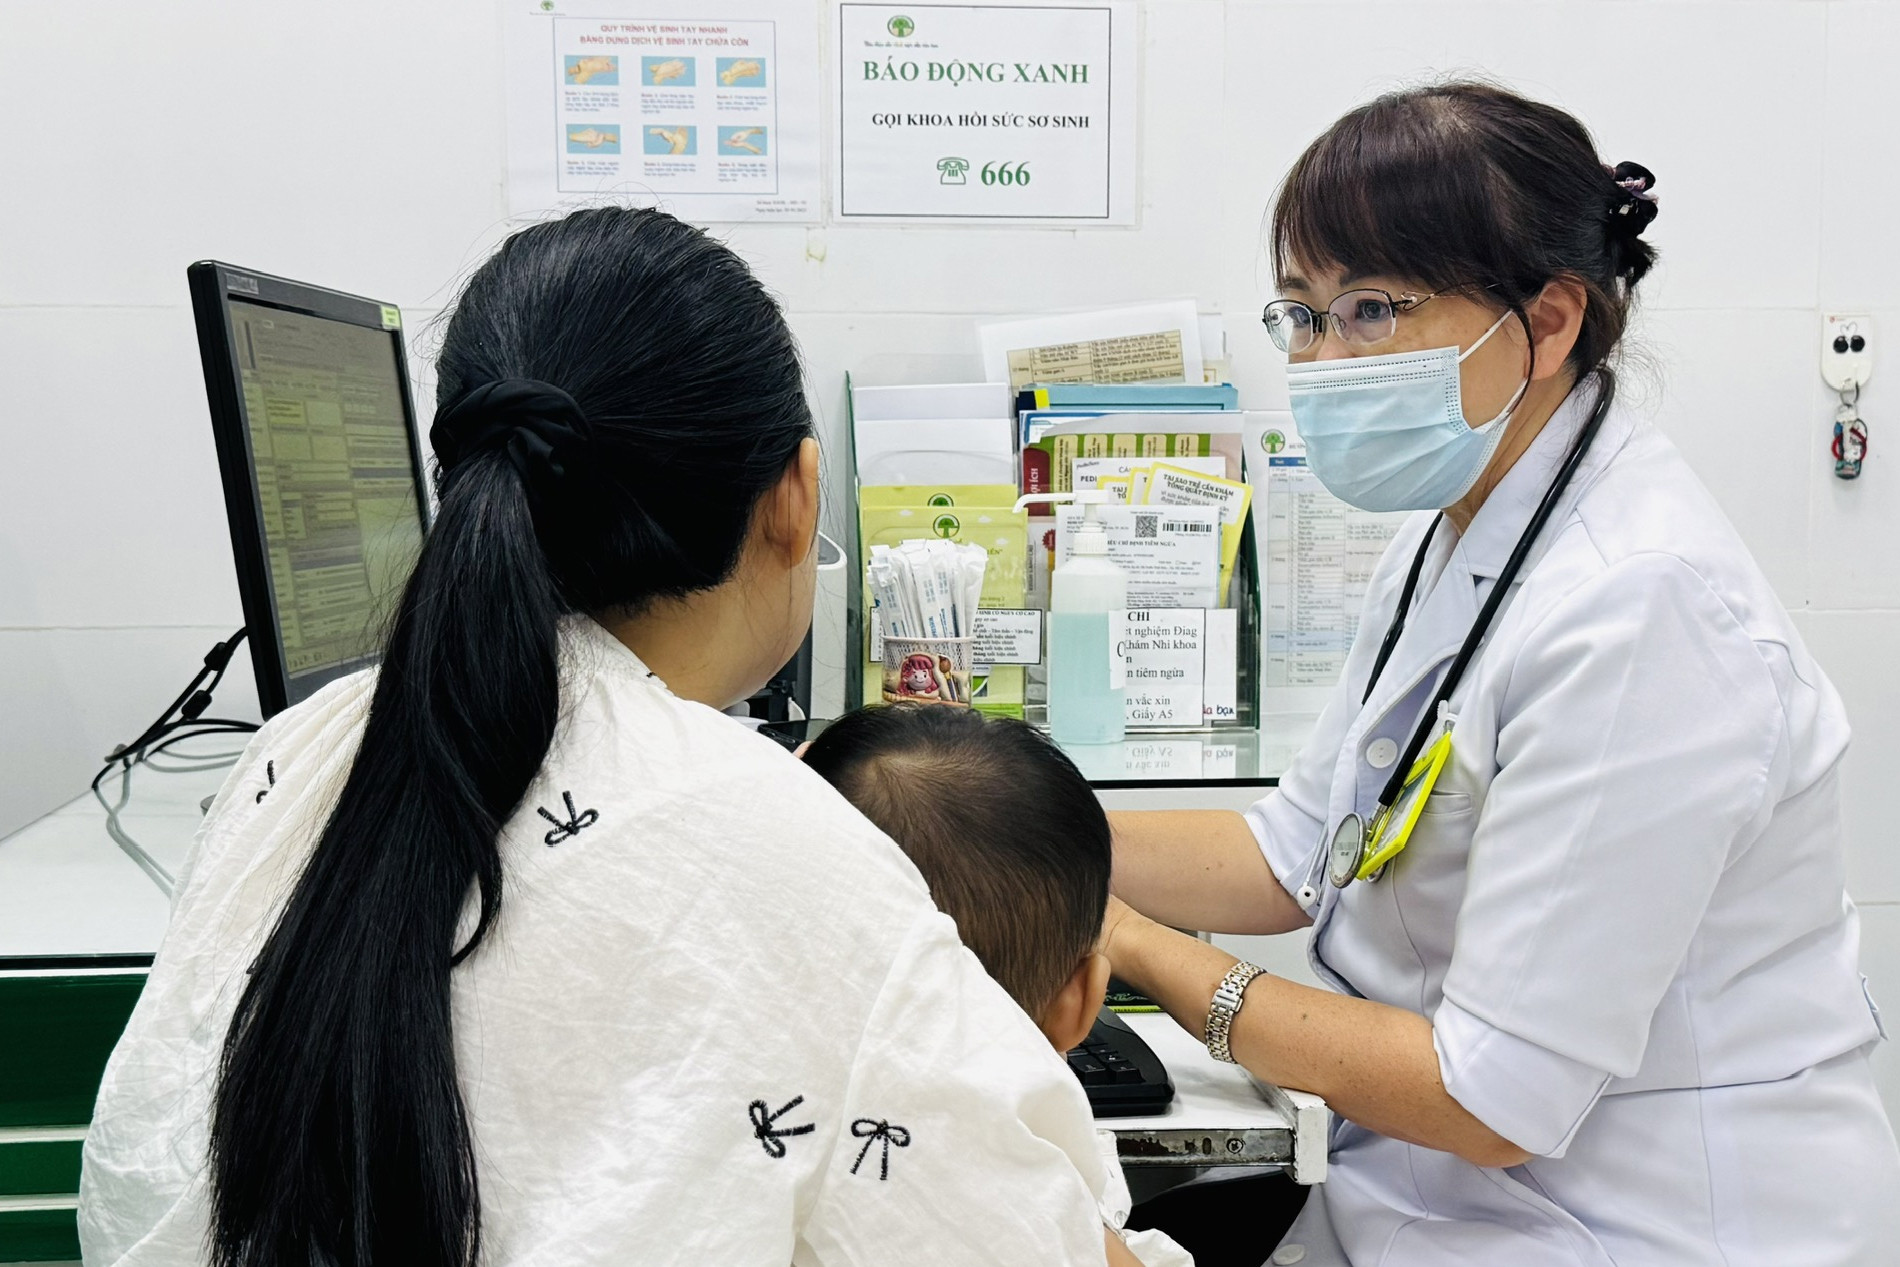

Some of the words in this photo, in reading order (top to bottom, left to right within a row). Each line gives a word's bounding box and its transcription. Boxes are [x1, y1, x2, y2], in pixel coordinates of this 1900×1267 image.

[600, 24, 618, 33] QUY
[863, 55, 920, 81] BÁO
[927, 59, 1005, 87] ĐỘNG
[1013, 63, 1090, 83] XANH
[872, 113, 902, 128] GỌI
[907, 114, 954, 126] KHOA
[958, 111, 988, 127] HỒI
[992, 112, 1024, 128] SỨC
[1027, 114, 1048, 128] SƠ
[1052, 115, 1090, 128] SINH
[981, 160, 1031, 186] 666
[1134, 626, 1171, 638] nghiệm
[1152, 640, 1170, 650] Nhi
[1173, 640, 1197, 649] khoa
[1136, 668, 1158, 678] tiêm
[1135, 693, 1152, 705] vắc
[1155, 695, 1170, 705] xin
[1132, 707, 1156, 721] Giấy
[1159, 710, 1173, 719] A5
